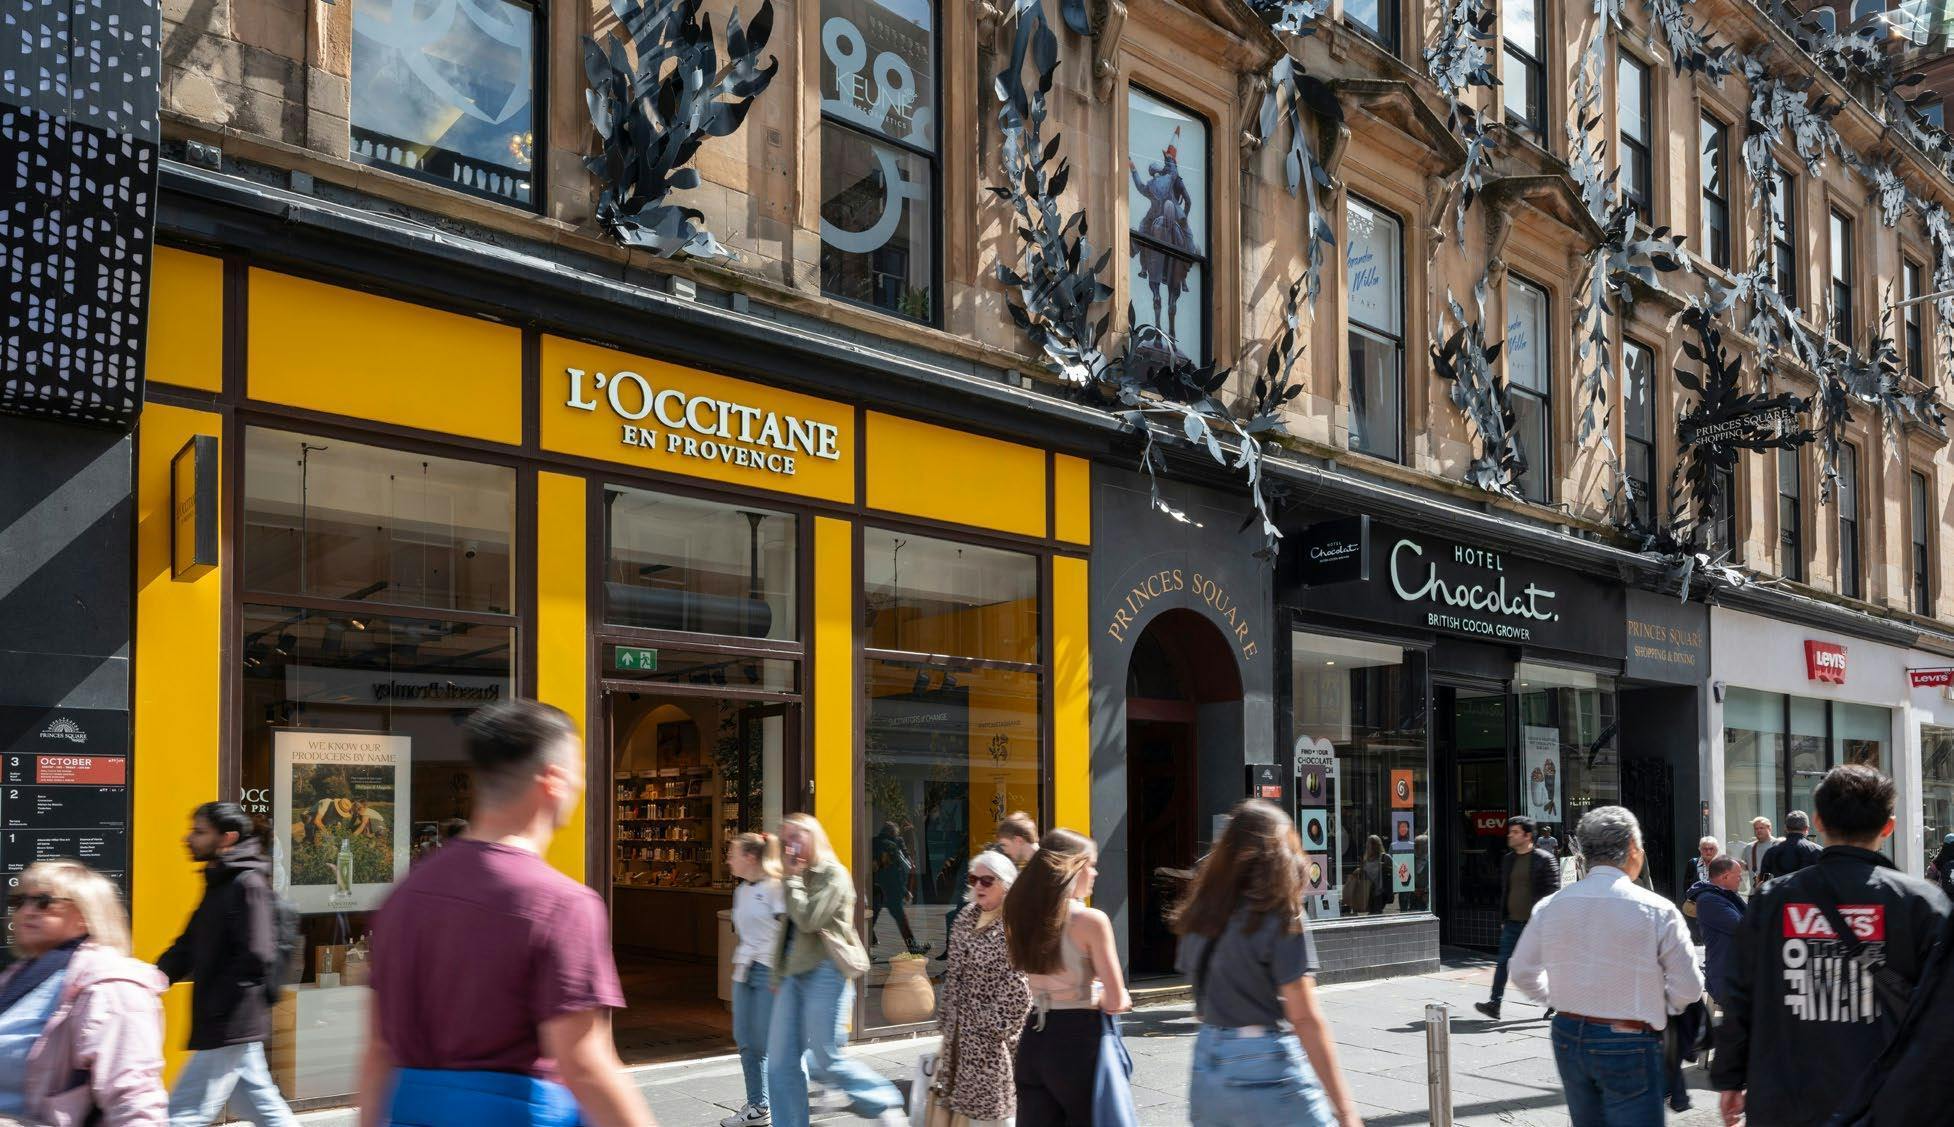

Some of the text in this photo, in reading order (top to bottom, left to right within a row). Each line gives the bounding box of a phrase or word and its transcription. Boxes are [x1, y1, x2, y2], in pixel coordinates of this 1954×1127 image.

[835, 65, 913, 120] KEUNE
[566, 367, 840, 460] L'OCCITANE
[1696, 408, 1789, 437] PRINCES SQUARE
[1695, 428, 1743, 446] SHOPPING
[622, 424, 796, 476] EN PROVENCE
[1454, 545, 1503, 571] HOTEL
[1107, 569, 1258, 661] PRINCES SQUARE
[1428, 612, 1530, 640] BRITISH COCOA GROWER
[1628, 620, 1703, 649] PRINCES SQUARE
[1634, 645, 1667, 661] SHOPPING
[1673, 652, 1695, 665] DINING
[65, 733, 87, 743] SQUARE
[308, 741, 382, 752] WE KNOW OUR
[11, 757, 19, 766] 3
[40, 757, 92, 766] OCTOBER
[292, 751, 397, 763] PRODUCERS BY NAME
[1297, 756, 1334, 765] CHOCOLATE
[10, 790, 19, 799] 2
[9, 833, 15, 843] 1
[8, 877, 19, 887] G
[1786, 906, 1877, 937] VAS
[1782, 938, 1808, 1021] OFF
